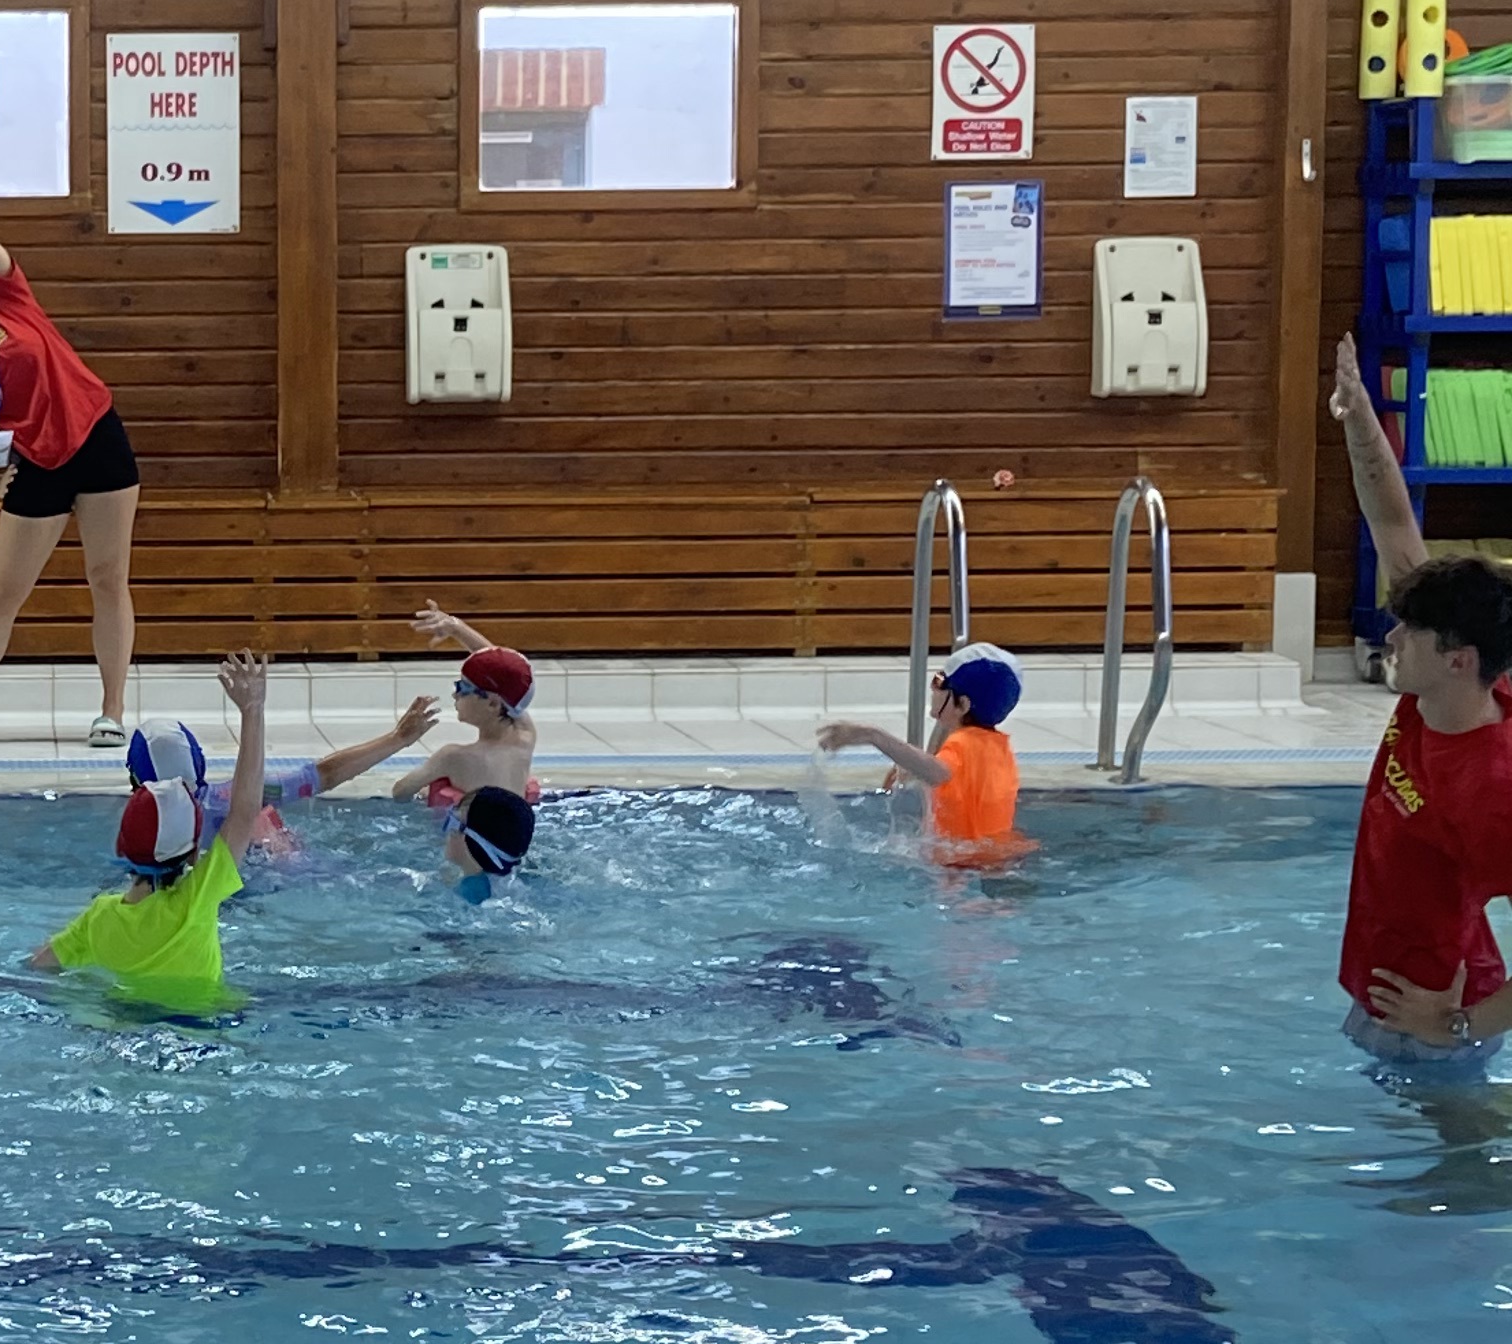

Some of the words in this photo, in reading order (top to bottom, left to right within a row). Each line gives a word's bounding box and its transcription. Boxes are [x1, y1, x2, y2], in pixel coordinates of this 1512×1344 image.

[112, 51, 166, 77] POOL
[175, 51, 235, 77] DEPTH
[149, 92, 198, 118] HERE
[960, 120, 1006, 131] CAUTION
[140, 162, 183, 182] 0.9
[187, 167, 211, 182] m
